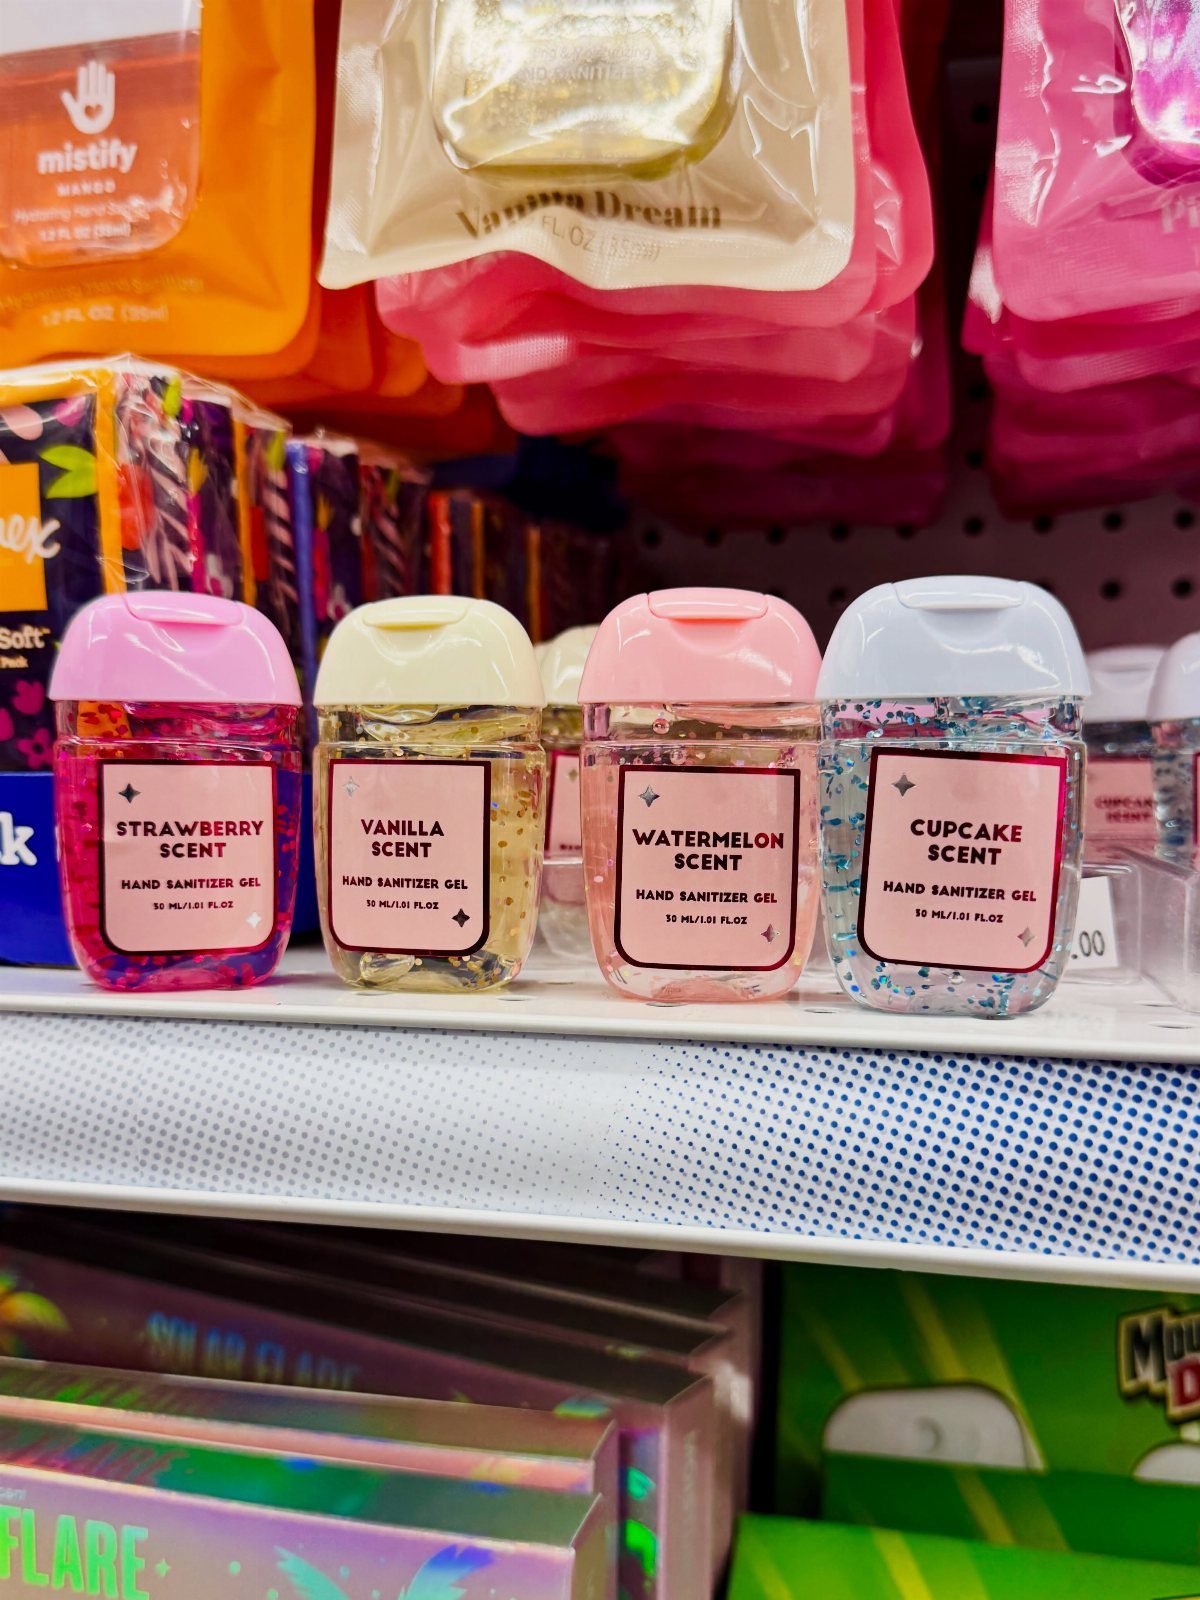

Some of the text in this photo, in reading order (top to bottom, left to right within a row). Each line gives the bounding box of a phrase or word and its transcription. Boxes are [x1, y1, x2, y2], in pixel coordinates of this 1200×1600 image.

[37, 138, 138, 175] mistify
[594, 190, 723, 230] Dream
[0, 513, 61, 565] ex
[116, 820, 264, 837] STRAWBERRY
[360, 818, 445, 837] VANILLA
[910, 818, 1023, 843] CUPCAKE
[631, 828, 785, 850] WATERMELON
[159, 842, 227, 859] SCENT
[371, 840, 432, 858] SCENT
[927, 844, 1002, 866] SCENT
[674, 852, 743, 871] SCENT
[121, 877, 261, 890] HAND SANITIZER GEL
[342, 875, 469, 890] HAND SANITIZER GEL
[883, 880, 1037, 902] HAND SANITIZER GEL
[207, 900, 234, 909] FL.OZ
[635, 888, 778, 904] HAND SANITIZER GEL
[413, 901, 439, 910] FL.OZ
[720, 915, 748, 925] FL.OZ
[974, 912, 1004, 924] FL.OZ
[0, 1504, 150, 1600] FLARE
